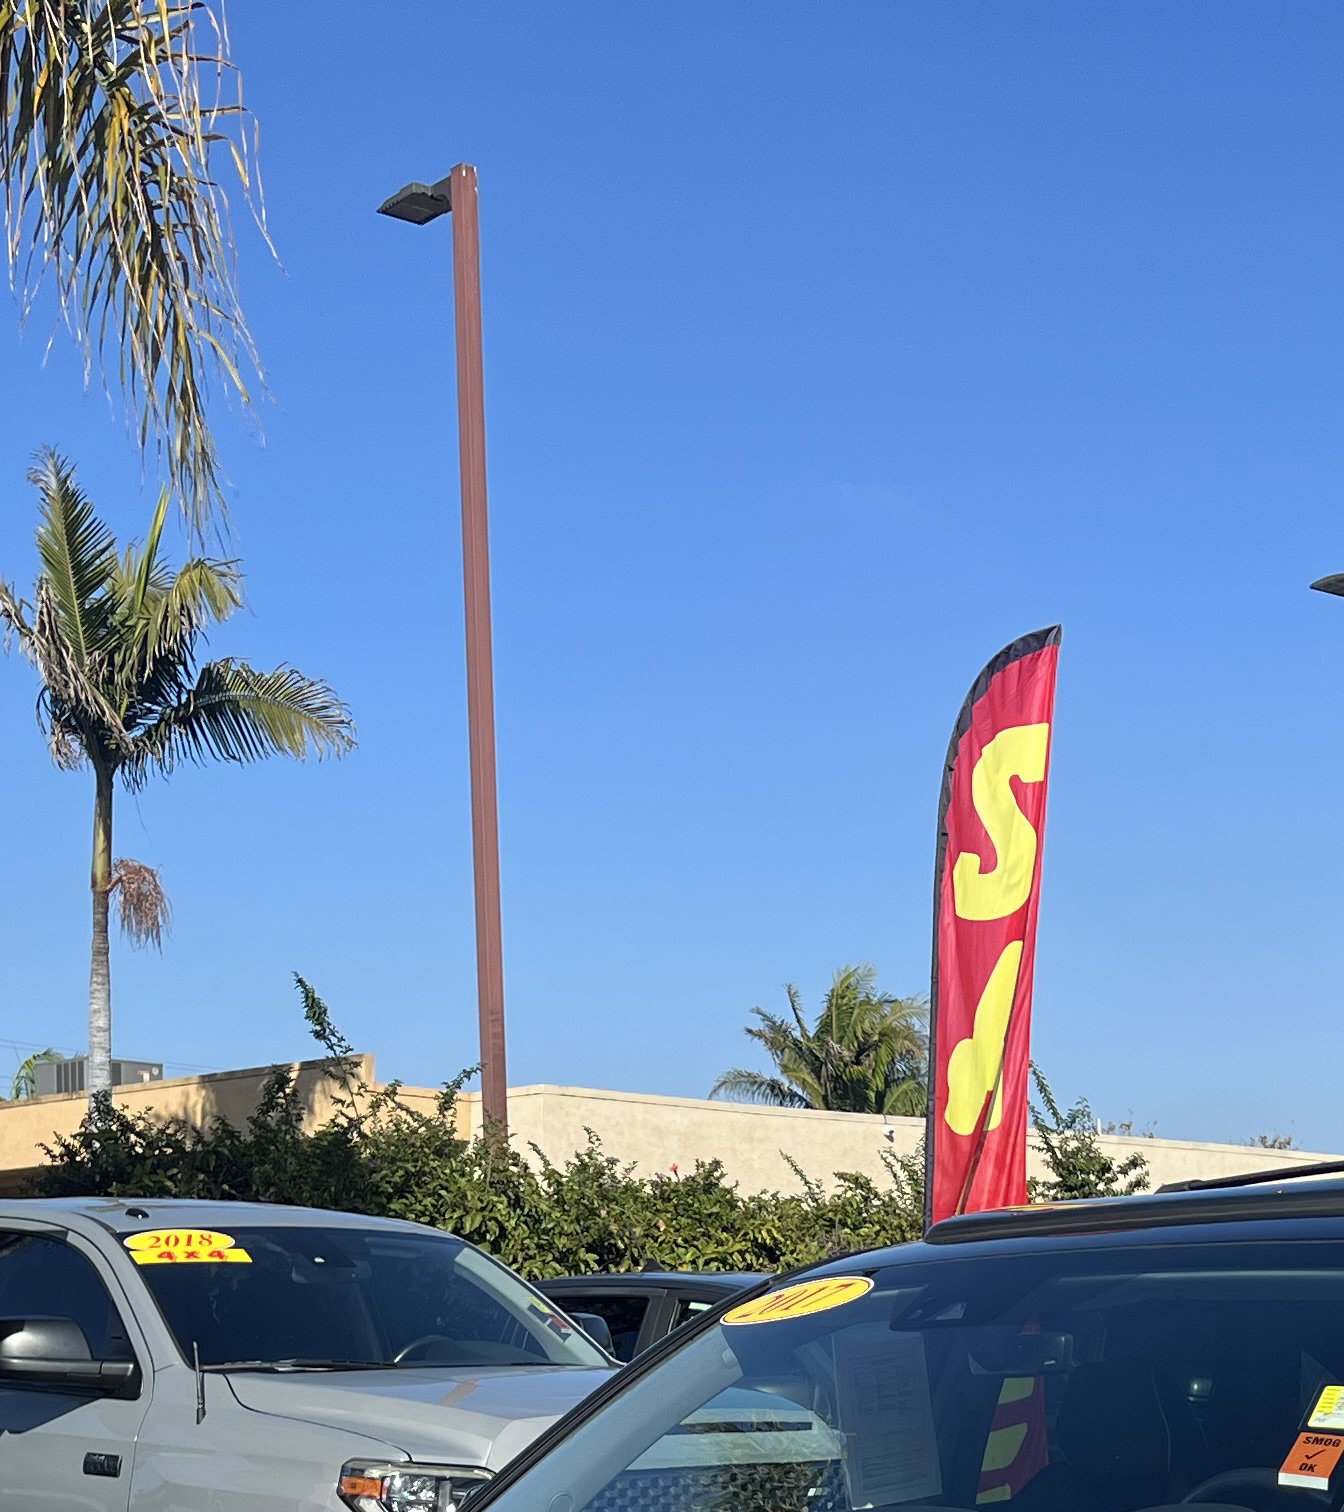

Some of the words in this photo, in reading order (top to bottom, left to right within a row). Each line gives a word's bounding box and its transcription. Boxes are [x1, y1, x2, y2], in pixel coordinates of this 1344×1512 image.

[148, 1233, 213, 1249] 2018
[1302, 1436, 1342, 1448] SMOG
[1298, 1462, 1318, 1473] OK
